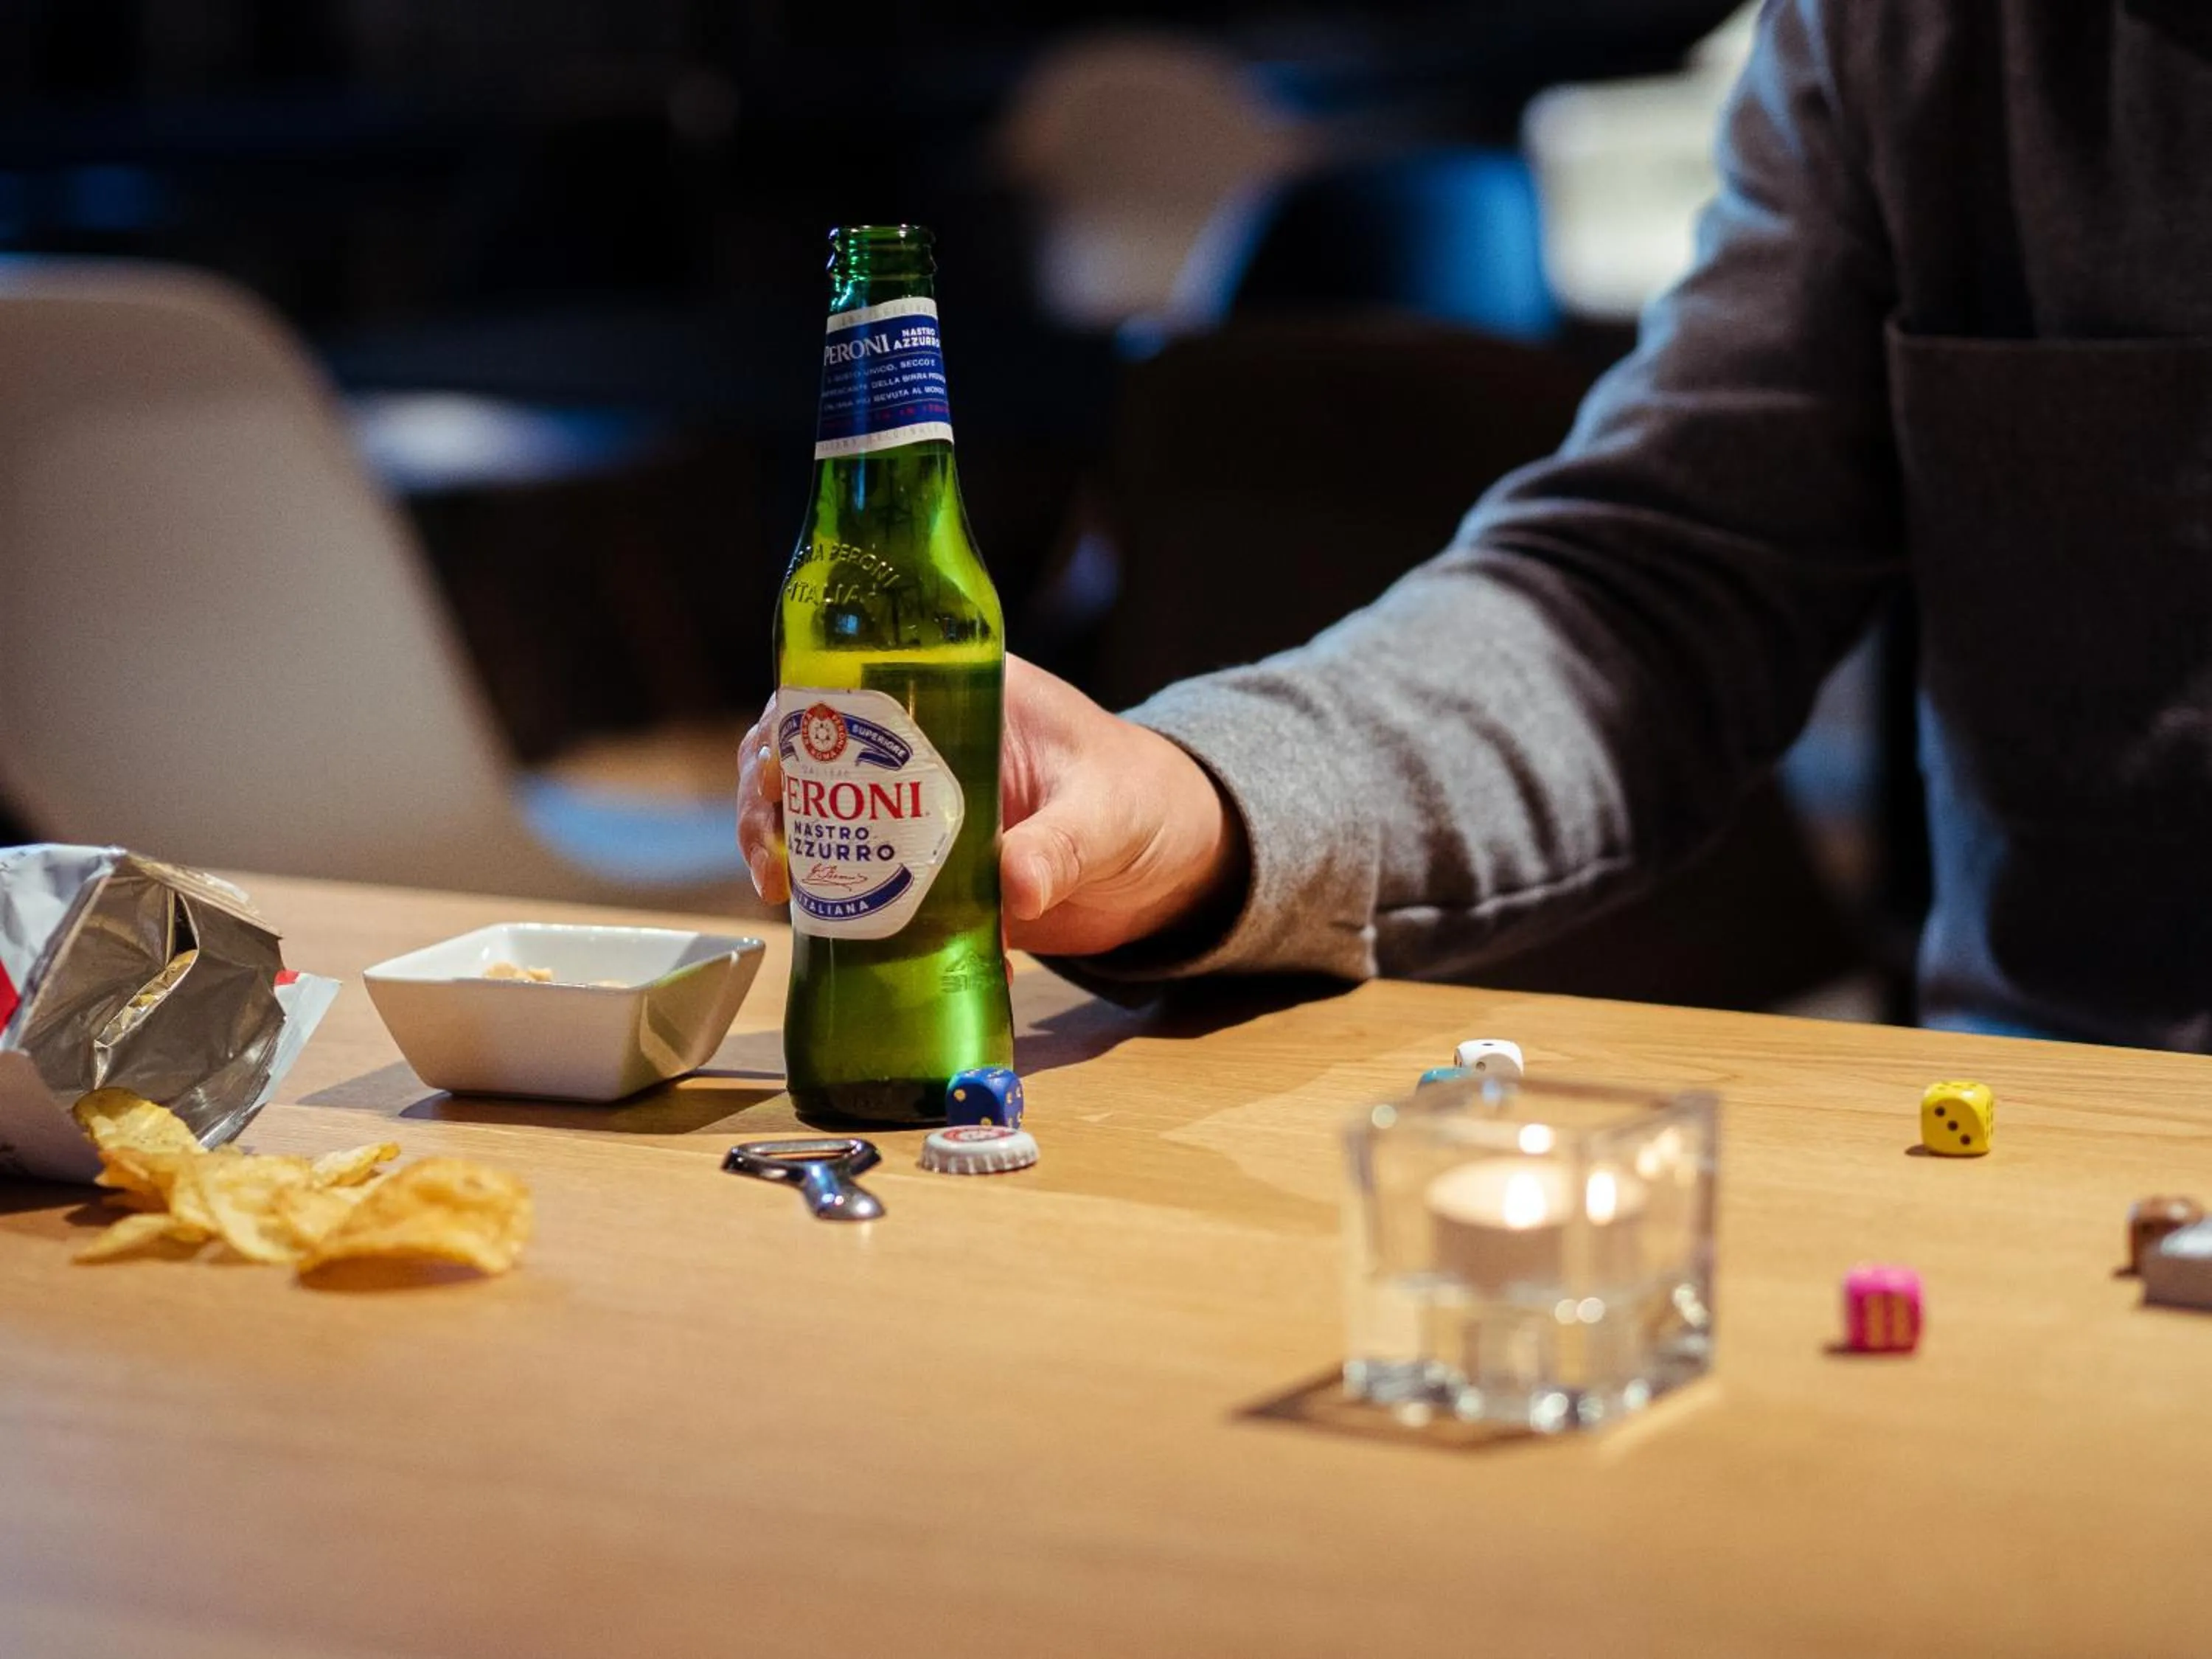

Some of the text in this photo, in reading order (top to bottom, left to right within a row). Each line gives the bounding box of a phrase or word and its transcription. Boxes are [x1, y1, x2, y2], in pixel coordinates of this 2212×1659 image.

[824, 333, 890, 366] PERONI
[852, 724, 906, 758] SUPERIORE
[786, 775, 922, 821] ERONI
[794, 820, 869, 840] NASTRO
[799, 892, 869, 915] ITALIANA
